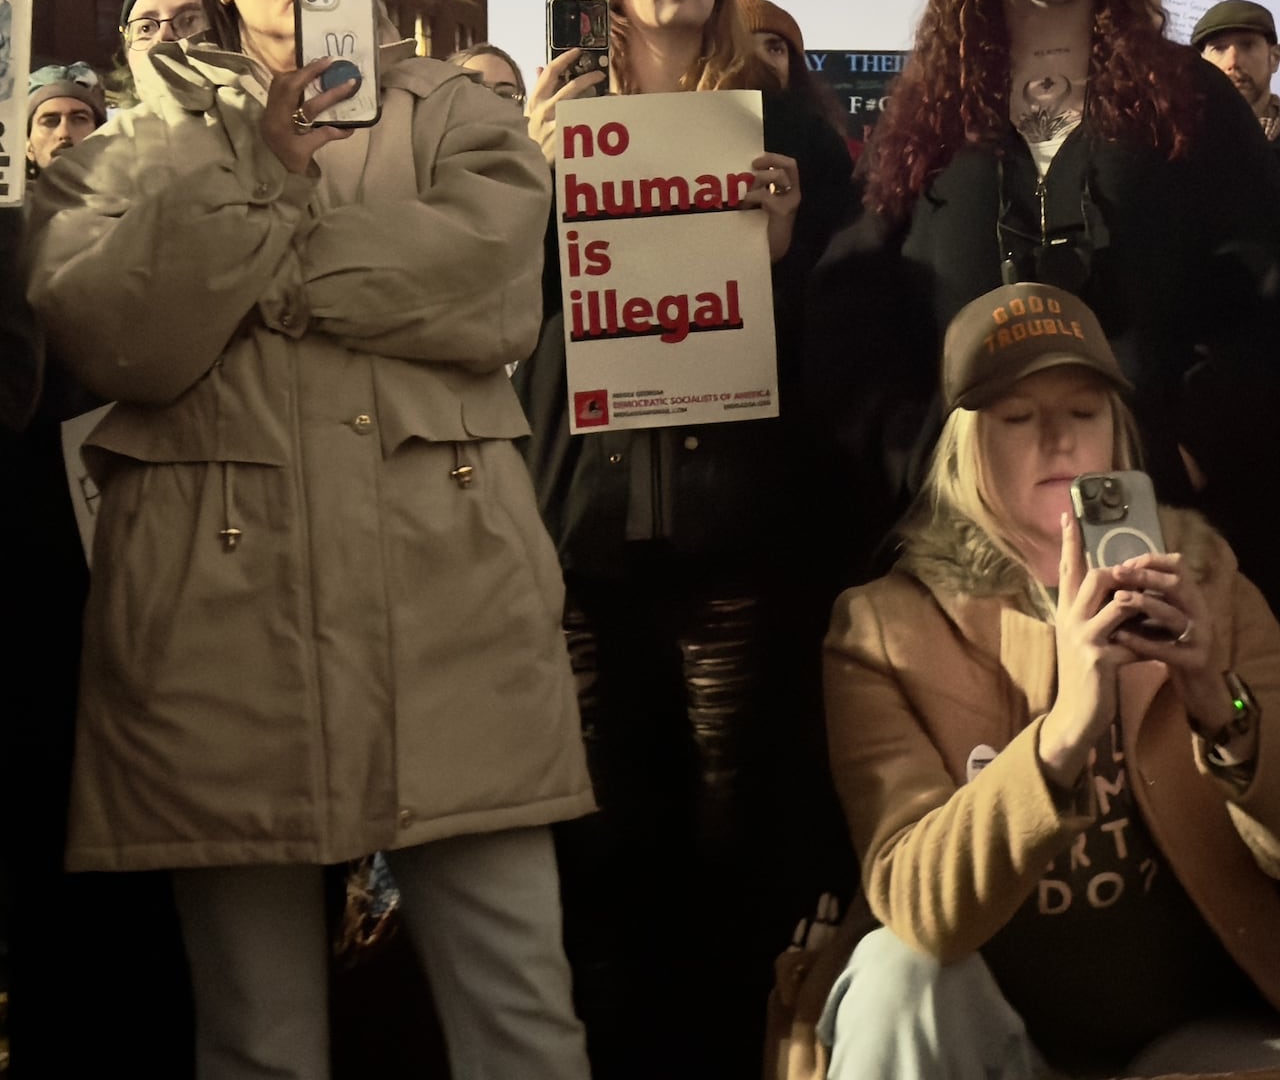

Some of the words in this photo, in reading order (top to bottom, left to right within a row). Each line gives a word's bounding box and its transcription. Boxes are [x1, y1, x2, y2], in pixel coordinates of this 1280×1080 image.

[845, 54, 908, 72] THEI
[563, 122, 630, 159] no
[564, 172, 756, 218] human
[566, 230, 612, 278] is
[570, 280, 742, 344] illegal
[991, 295, 1062, 326] GOOD
[983, 318, 1085, 355] TROUBLE
